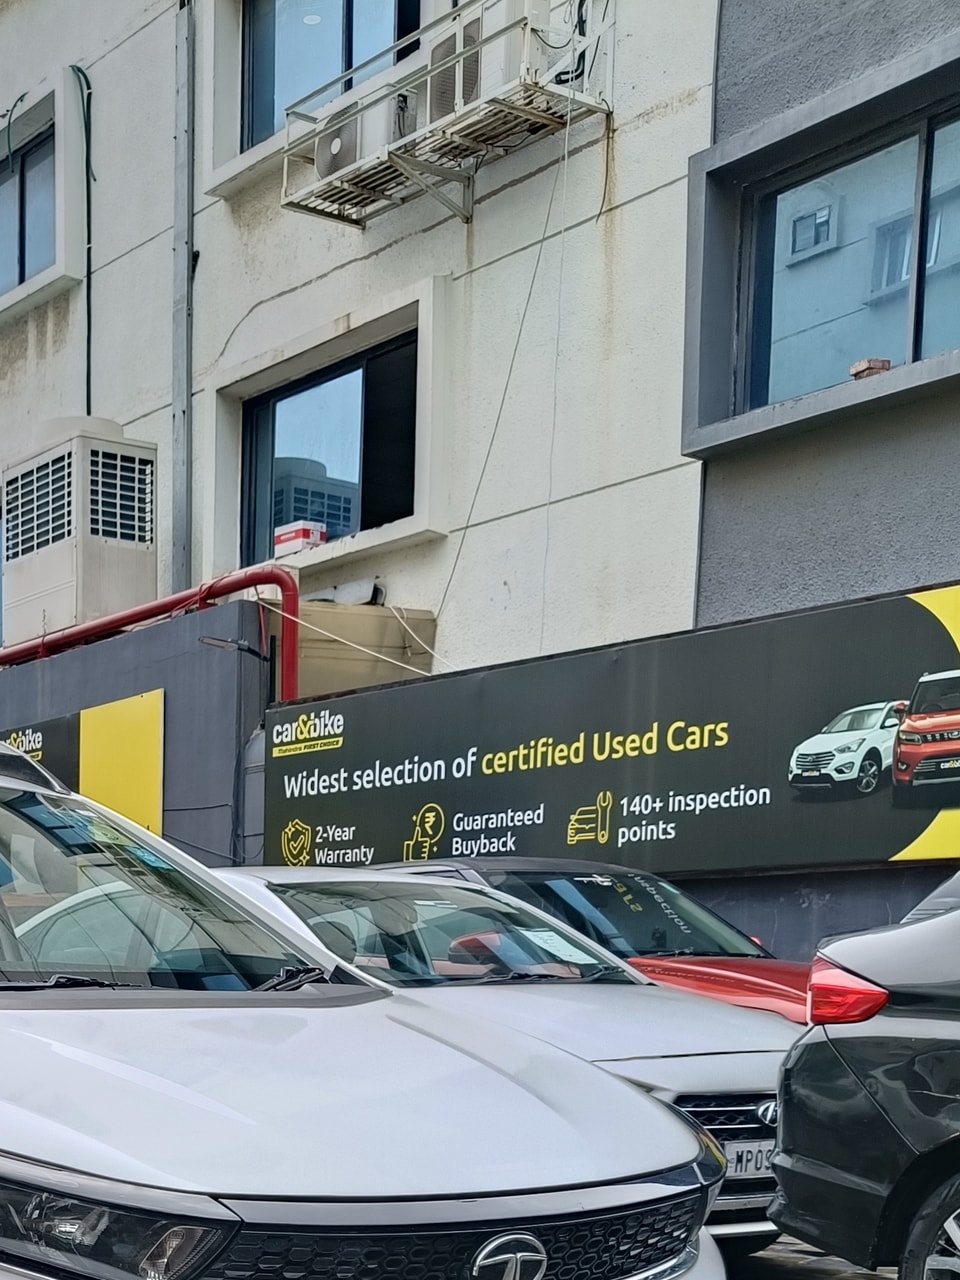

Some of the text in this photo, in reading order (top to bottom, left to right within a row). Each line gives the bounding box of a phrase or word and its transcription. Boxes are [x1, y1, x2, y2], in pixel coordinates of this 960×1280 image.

[3, 728, 43, 752] &bike
[272, 709, 344, 744] car&bike
[283, 720, 729, 799] Widest selection of certified Used Cars
[619, 784, 771, 817] 140+ inspection
[452, 803, 545, 832] Guaranteed
[315, 825, 356, 843] 2-Year
[451, 832, 516, 857] Buyback
[617, 820, 676, 848] points
[314, 845, 375, 865] Warranty
